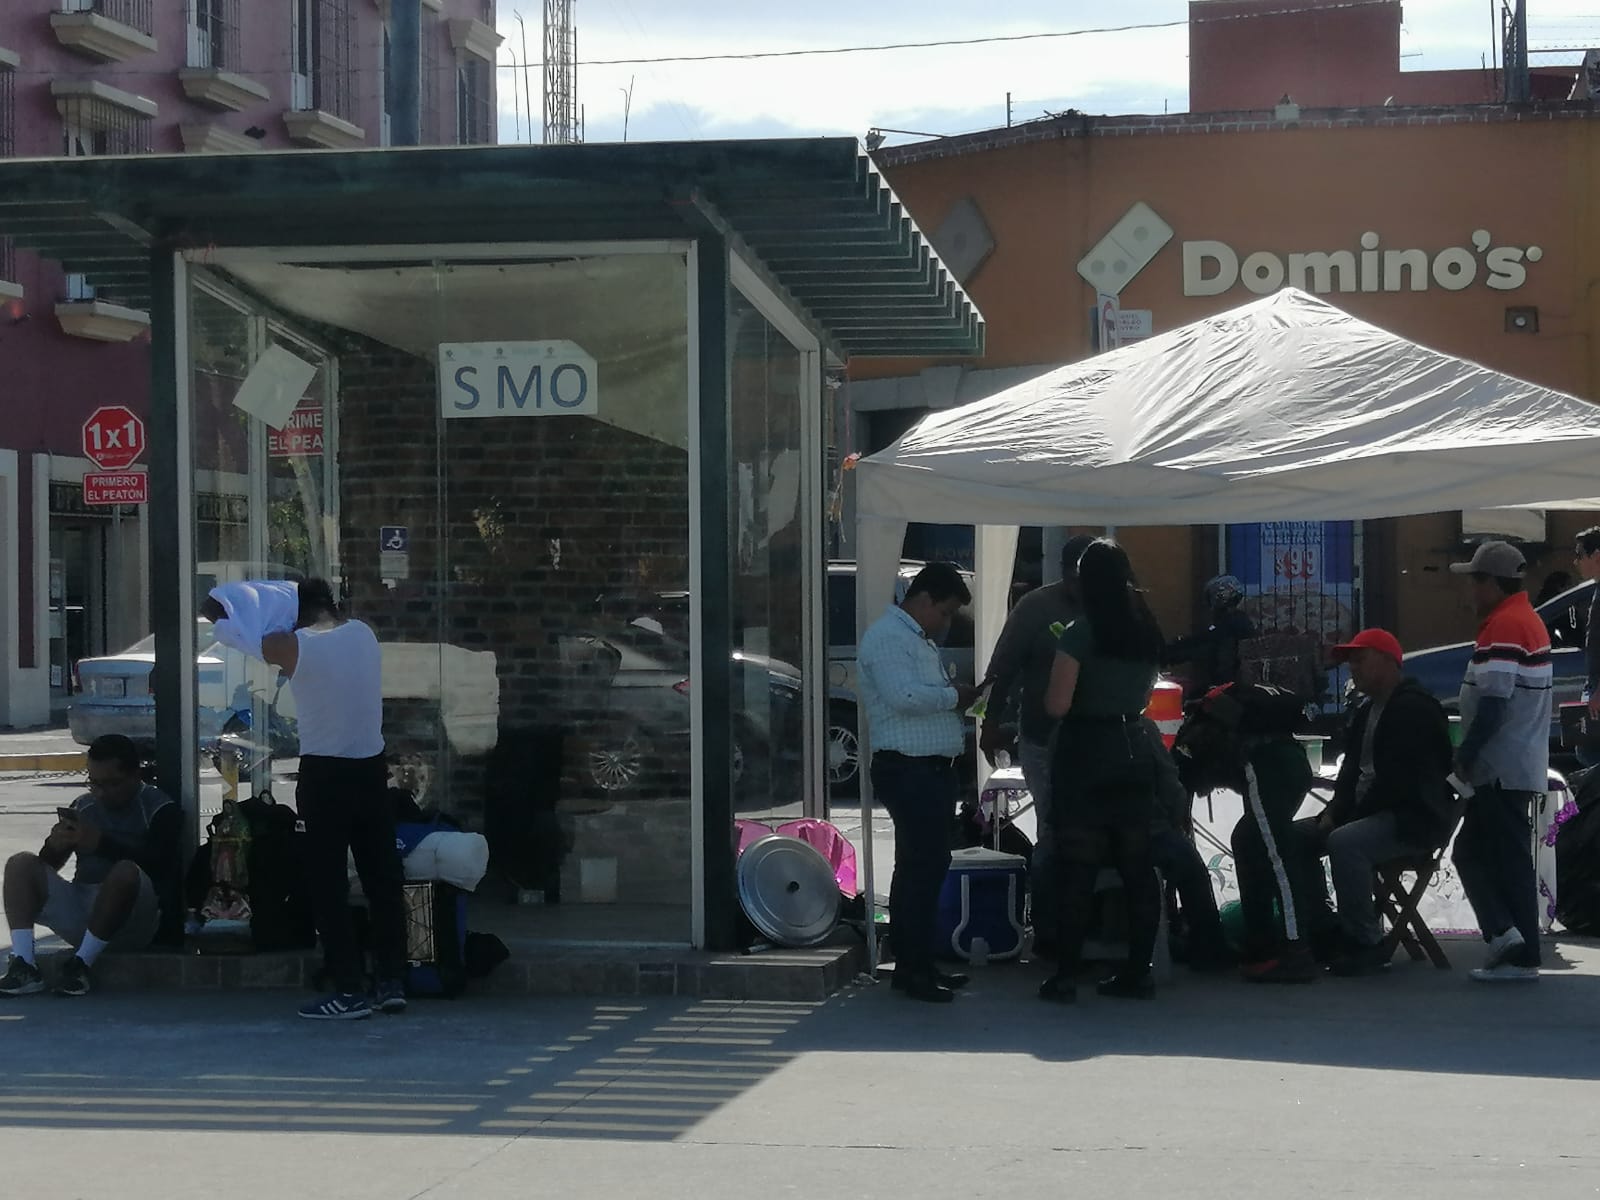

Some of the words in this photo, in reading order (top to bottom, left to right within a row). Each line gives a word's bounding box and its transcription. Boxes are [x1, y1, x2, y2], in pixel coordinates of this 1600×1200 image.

[1182, 228, 1527, 296] Domino's
[286, 413, 323, 429] RIME
[268, 436, 289, 451] EL
[291, 434, 323, 449] PEA
[91, 476, 138, 488] PRIMERO
[87, 490, 101, 501] EL
